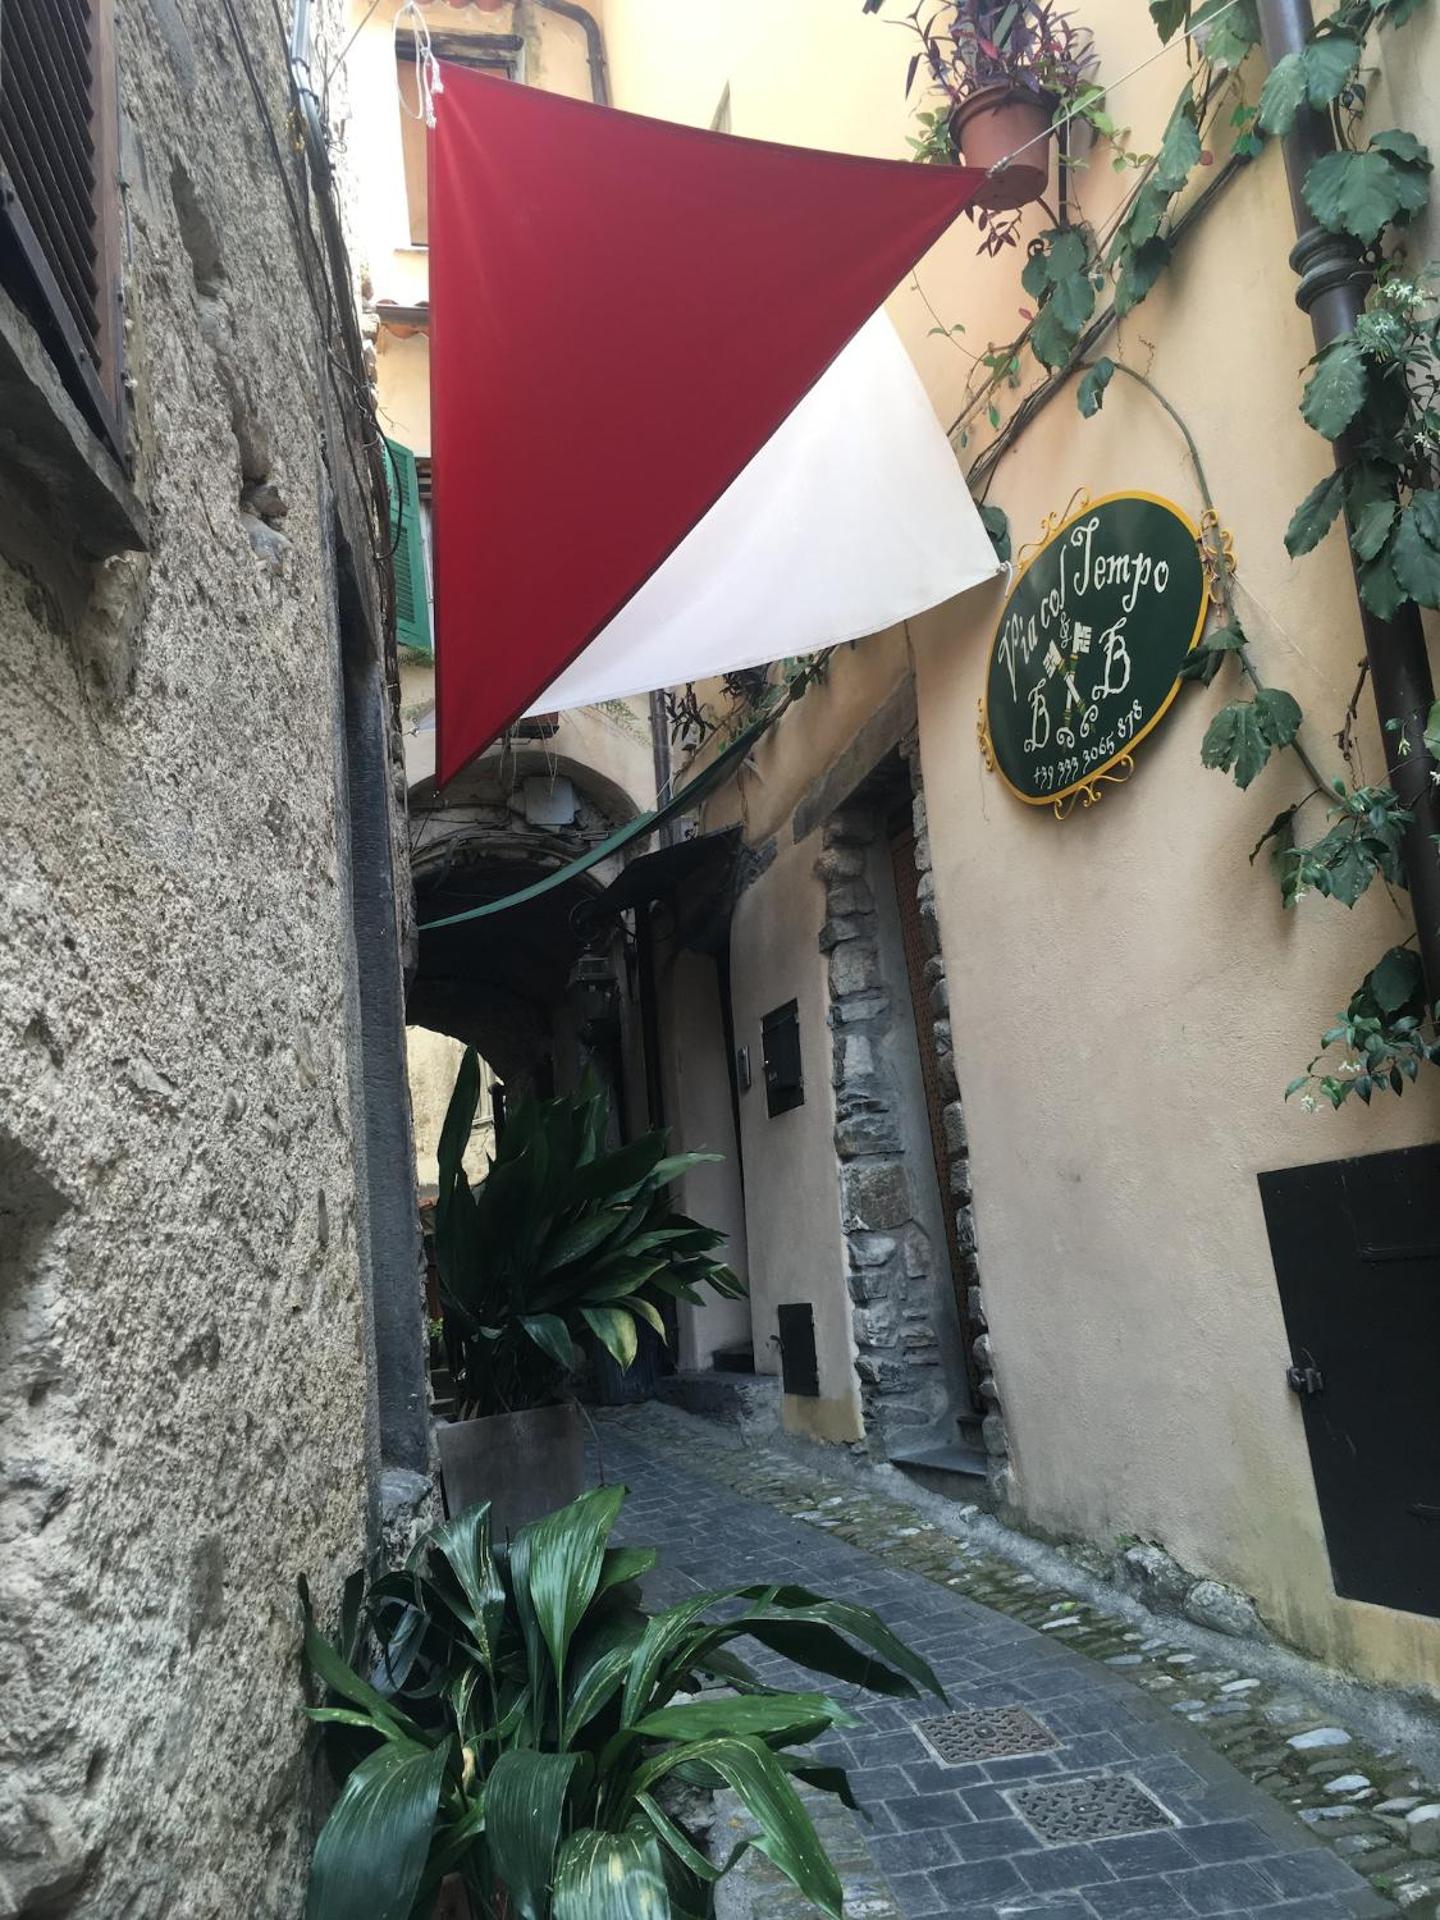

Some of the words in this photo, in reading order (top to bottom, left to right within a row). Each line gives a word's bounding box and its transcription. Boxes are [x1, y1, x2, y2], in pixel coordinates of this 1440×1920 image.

[998, 613, 1037, 702] Via
[1041, 544, 1067, 628] col
[1070, 516, 1169, 613] Tempo
[1024, 678, 1050, 752] B
[1060, 611, 1072, 649] &
[1092, 617, 1131, 700] B
[1033, 765, 1054, 789] +39
[1057, 756, 1079, 786] 333
[1082, 731, 1115, 774] 3065
[1117, 698, 1143, 739] 878
